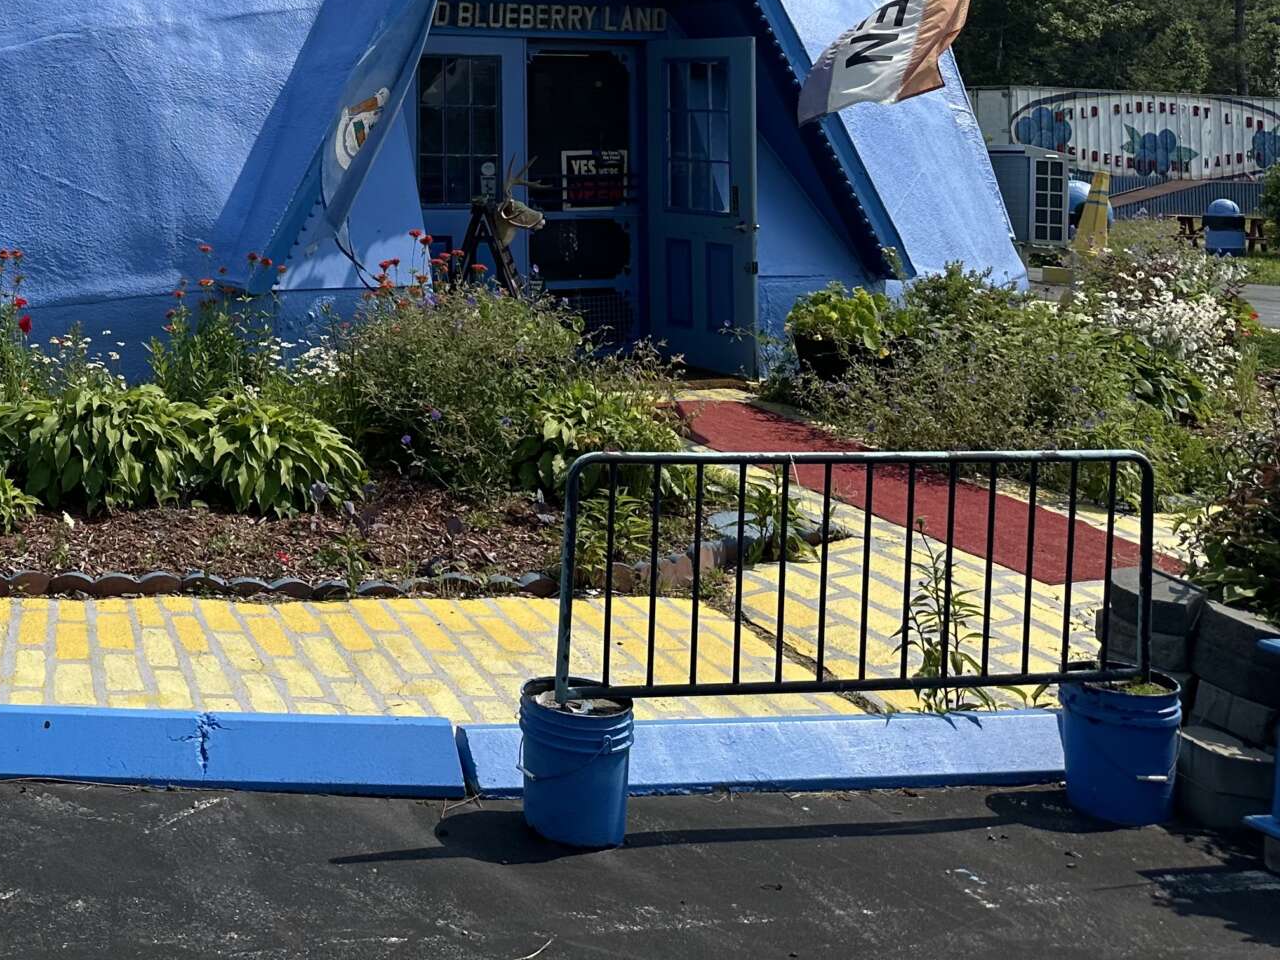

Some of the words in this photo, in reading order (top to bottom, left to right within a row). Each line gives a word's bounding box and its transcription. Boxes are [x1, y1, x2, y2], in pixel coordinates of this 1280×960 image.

[457, 1, 598, 31] BLUEBERRY
[604, 6, 668, 32] LAND
[1055, 106, 1099, 123] WILD
[1113, 101, 1211, 120] BLUEBERRY
[1224, 112, 1264, 131] LAND
[570, 159, 597, 176] YES
